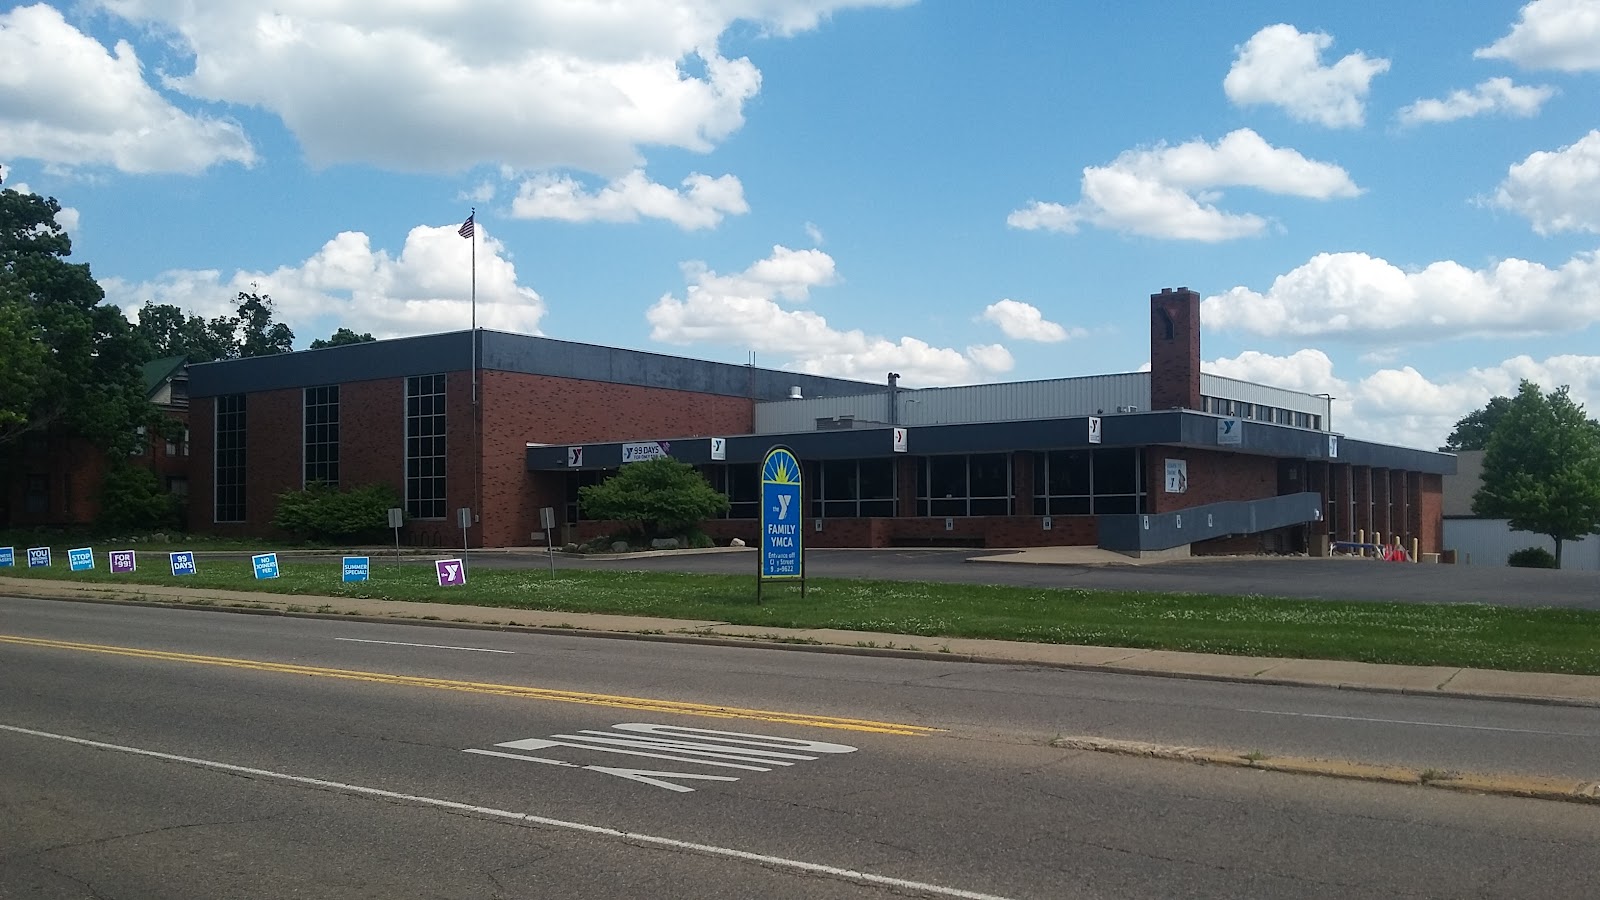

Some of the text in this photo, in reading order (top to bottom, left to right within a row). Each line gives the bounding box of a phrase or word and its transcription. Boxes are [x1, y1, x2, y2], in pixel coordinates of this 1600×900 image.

[634, 446, 642, 455] 99
[643, 445, 659, 454] DAYS
[768, 524, 796, 535] FAMILY
[771, 536, 793, 547] YMCA
[72, 553, 90, 561] STOP
[114, 554, 130, 562] FOR
[177, 555, 187, 563] 99
[174, 562, 192, 570] DAYS
[256, 562, 276, 570] JOINERS
